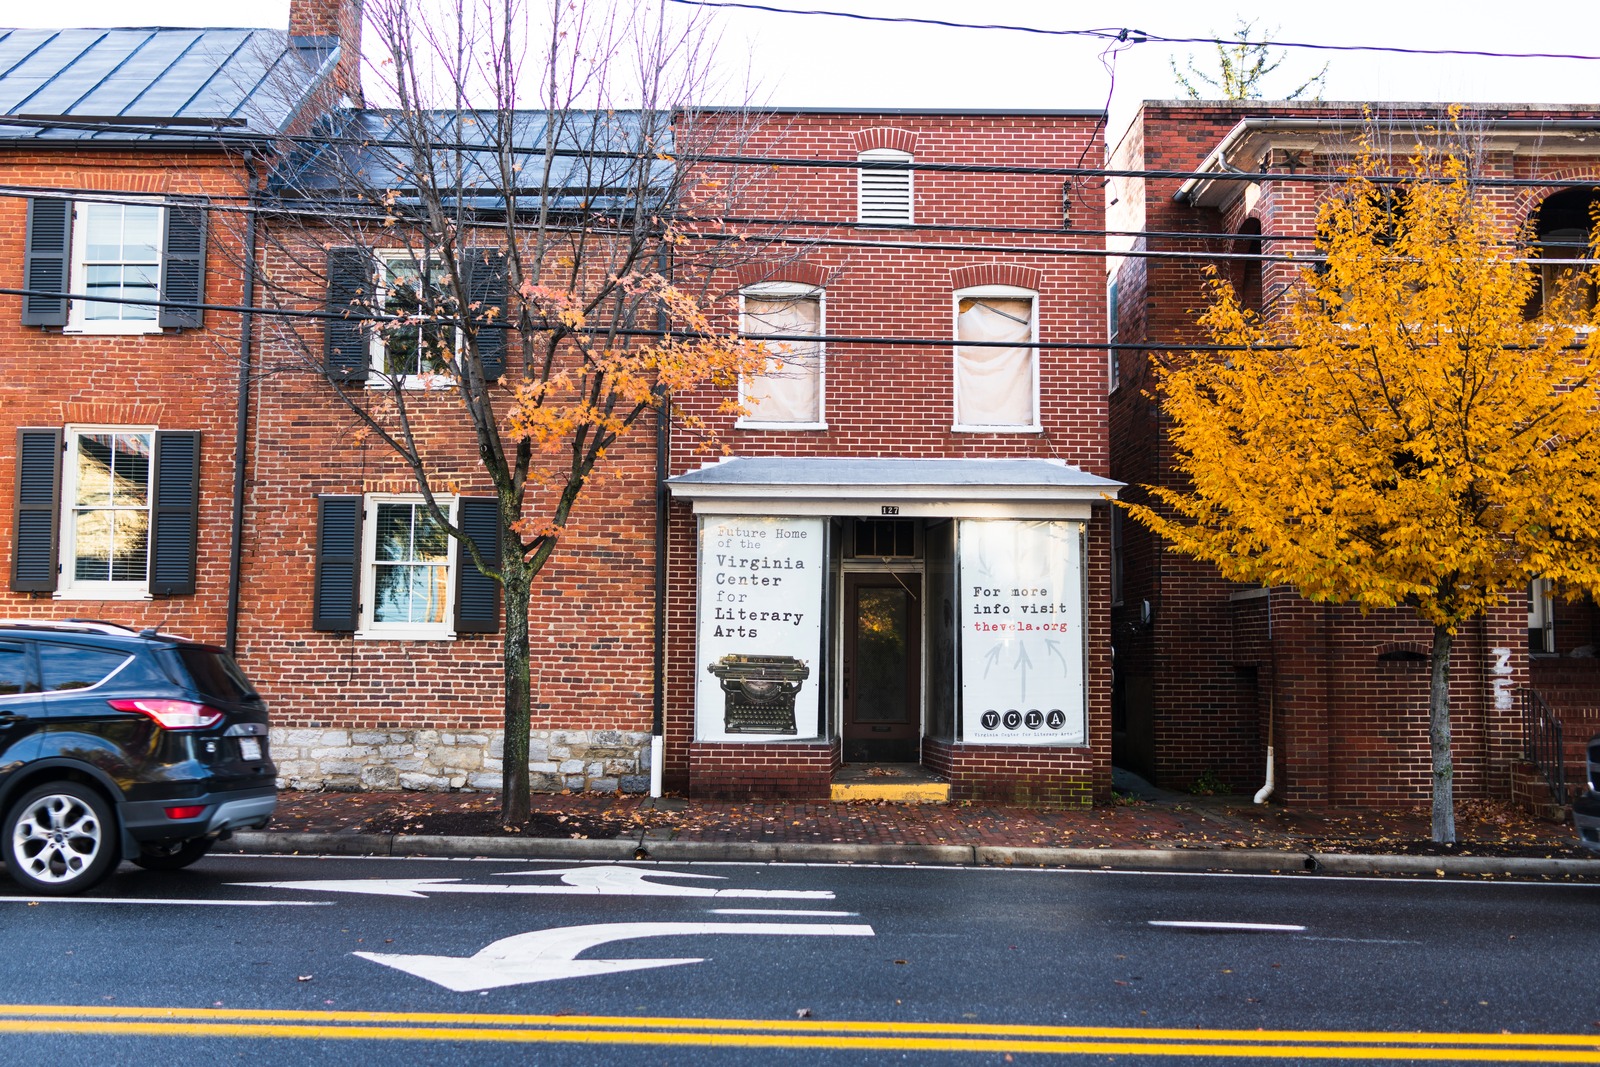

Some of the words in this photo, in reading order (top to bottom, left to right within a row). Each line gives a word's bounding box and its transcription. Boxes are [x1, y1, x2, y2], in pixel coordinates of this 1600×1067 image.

[882, 506, 899, 514] 127
[717, 526, 767, 538] Future
[775, 528, 808, 539] Home
[717, 539, 732, 548] of
[740, 539, 761, 549] the
[716, 554, 805, 570] Virginia
[716, 573, 782, 586] Center
[717, 590, 748, 603] for
[973, 586, 1001, 597] For
[1011, 587, 1048, 597] more
[973, 604, 1011, 614] info
[1021, 603, 1067, 614] visit
[714, 607, 804, 626] Literary
[713, 625, 758, 638] Arts
[974, 621, 1068, 632] thevcla.org
